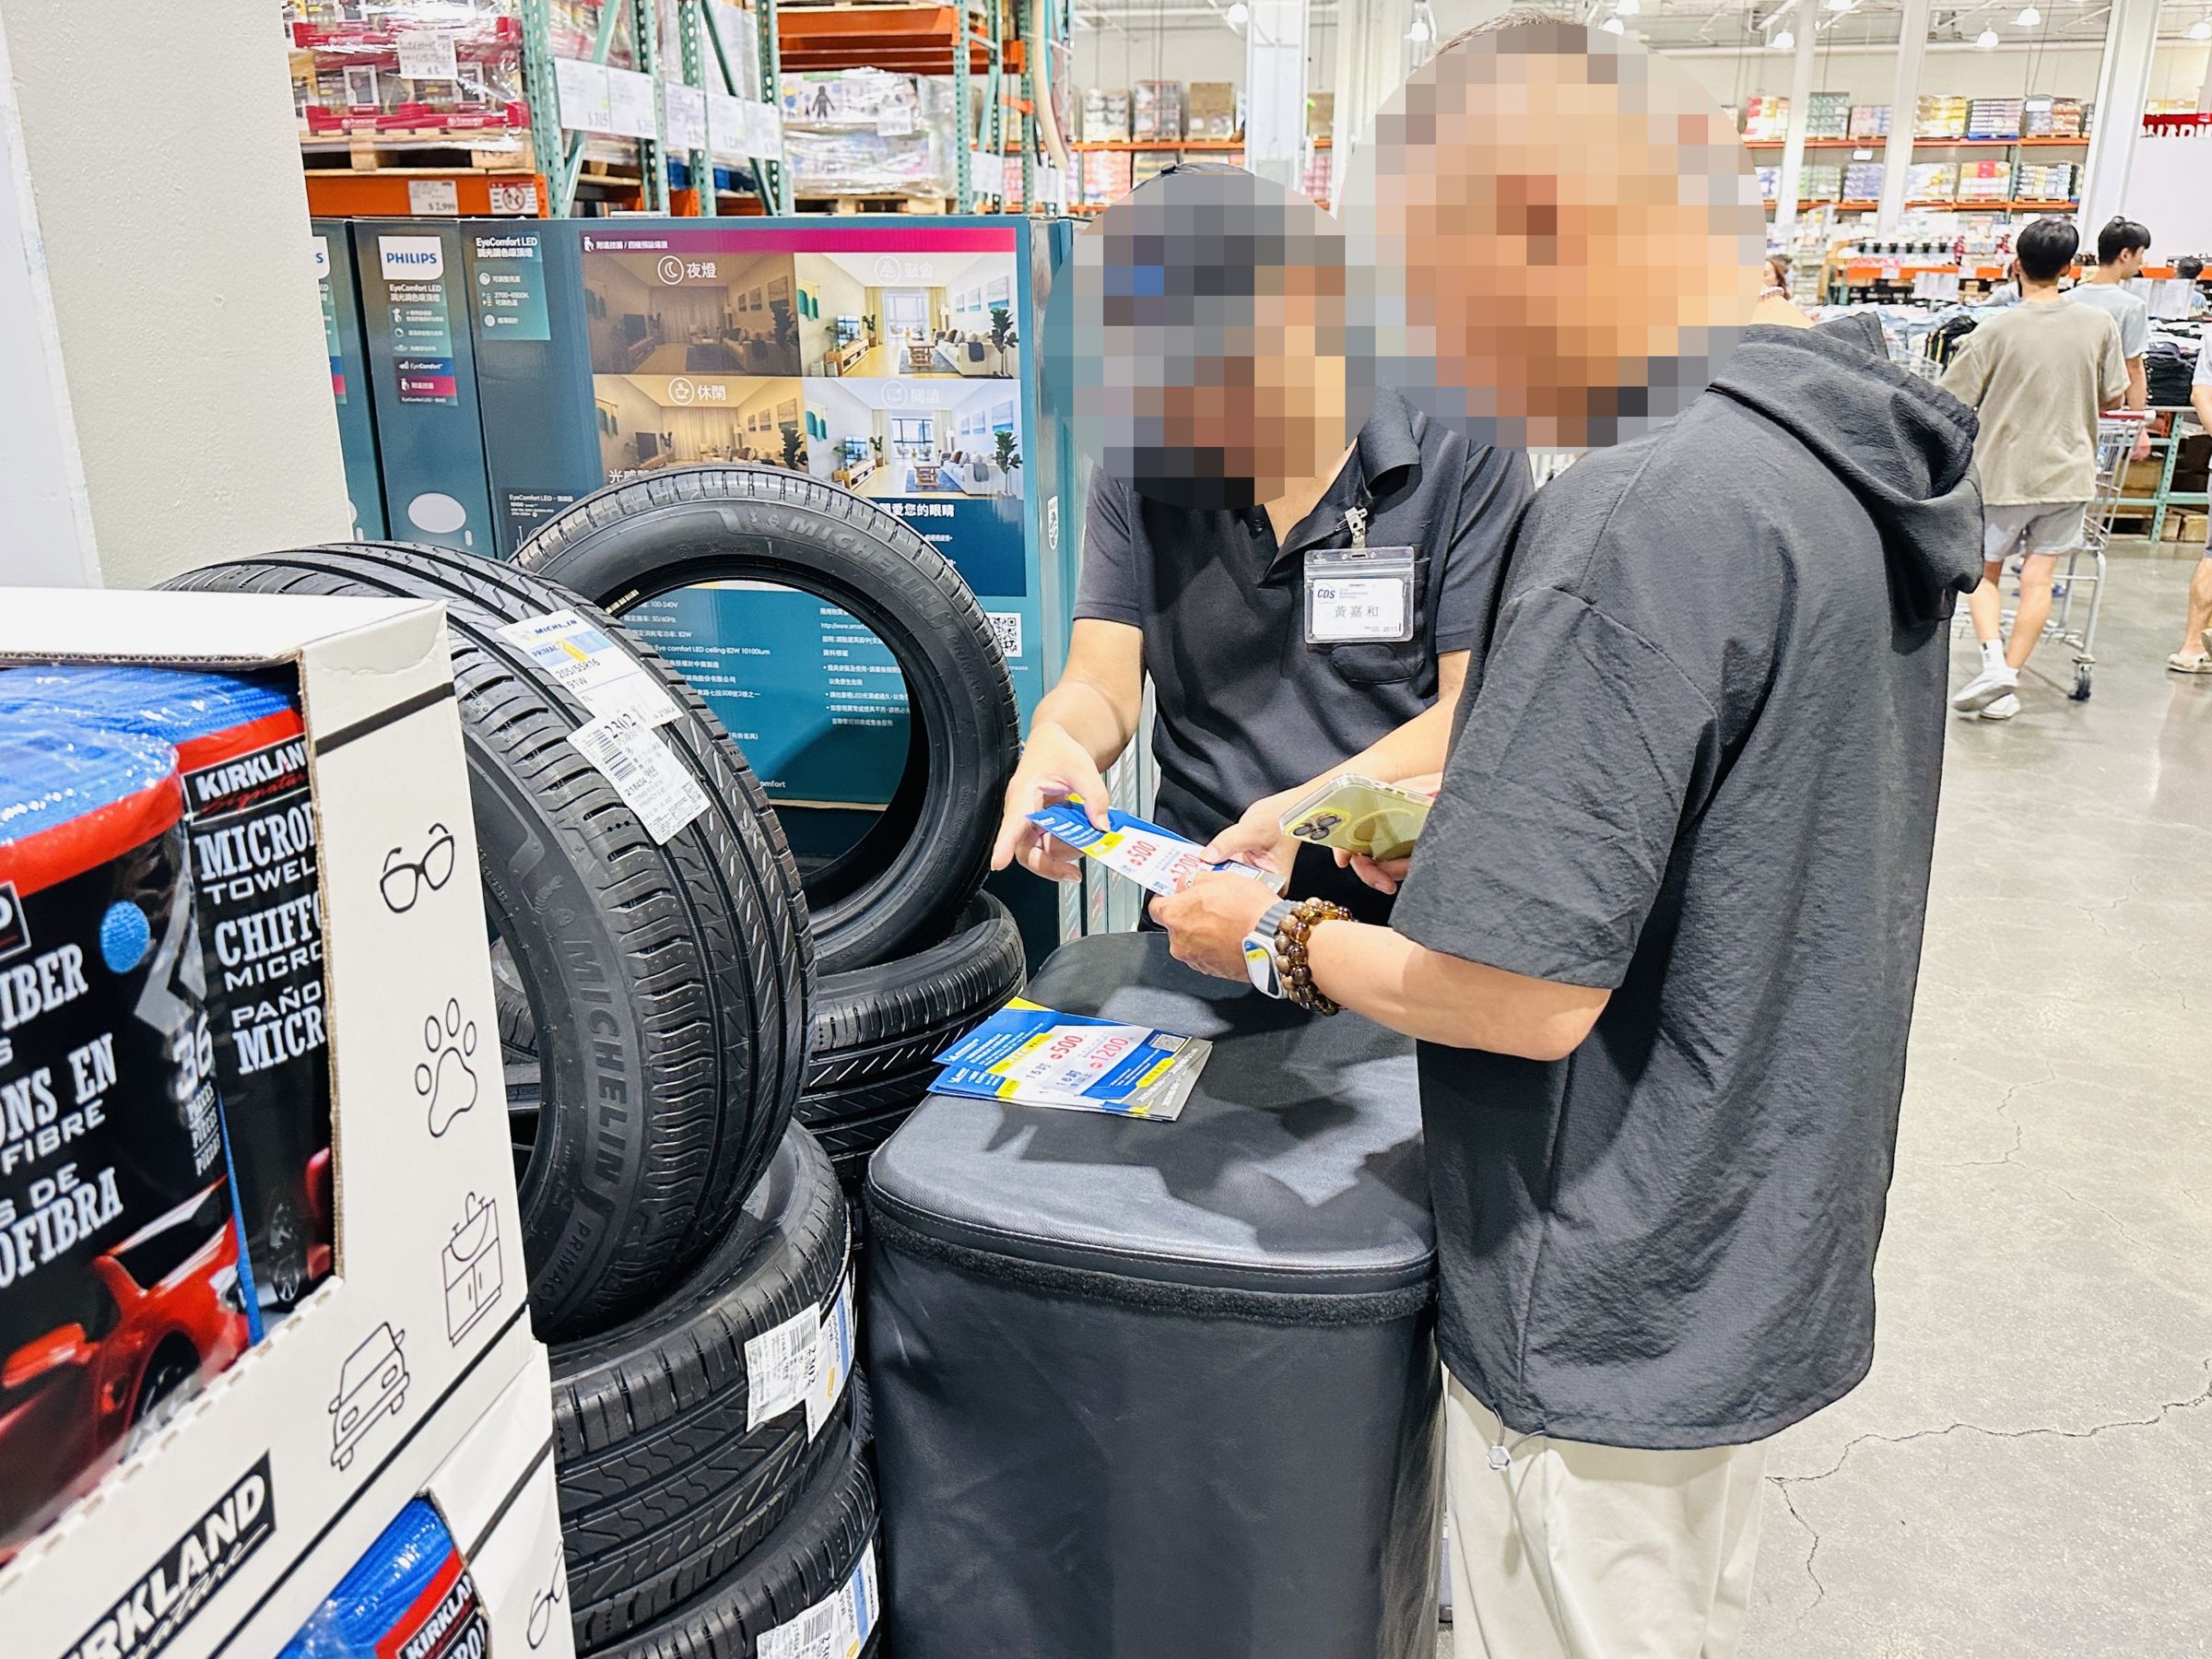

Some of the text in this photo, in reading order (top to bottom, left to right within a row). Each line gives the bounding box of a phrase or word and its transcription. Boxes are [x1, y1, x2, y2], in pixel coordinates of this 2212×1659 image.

[476, 236, 538, 248] EyeComfort LED
[386, 253, 437, 265] PHILIPS
[686, 263, 717, 278] 夜燈
[788, 514, 939, 618] MICHELIN
[1317, 588, 1335, 599] CDS
[652, 615, 677, 623] 50/60Hz
[655, 644, 666, 653] Eye
[667, 644, 692, 653] comfort
[705, 646, 726, 654] ceiling
[555, 657, 601, 679] 205/55R16
[566, 676, 588, 689] 91W
[604, 712, 637, 739] 2302
[759, 780, 786, 788] omfort
[1127, 840, 1158, 862] 500
[1055, 1034, 1084, 1054] 500
[1090, 1037, 1130, 1061] 1200
[172, 1012, 214, 1100] 36
[561, 939, 629, 1185] MICHELIN
[68, 1032, 118, 1106] EN
[29, 1162, 81, 1210] DE
[807, 1344, 818, 1388] 2302
[66, 1474, 266, 1659] RKLAND
